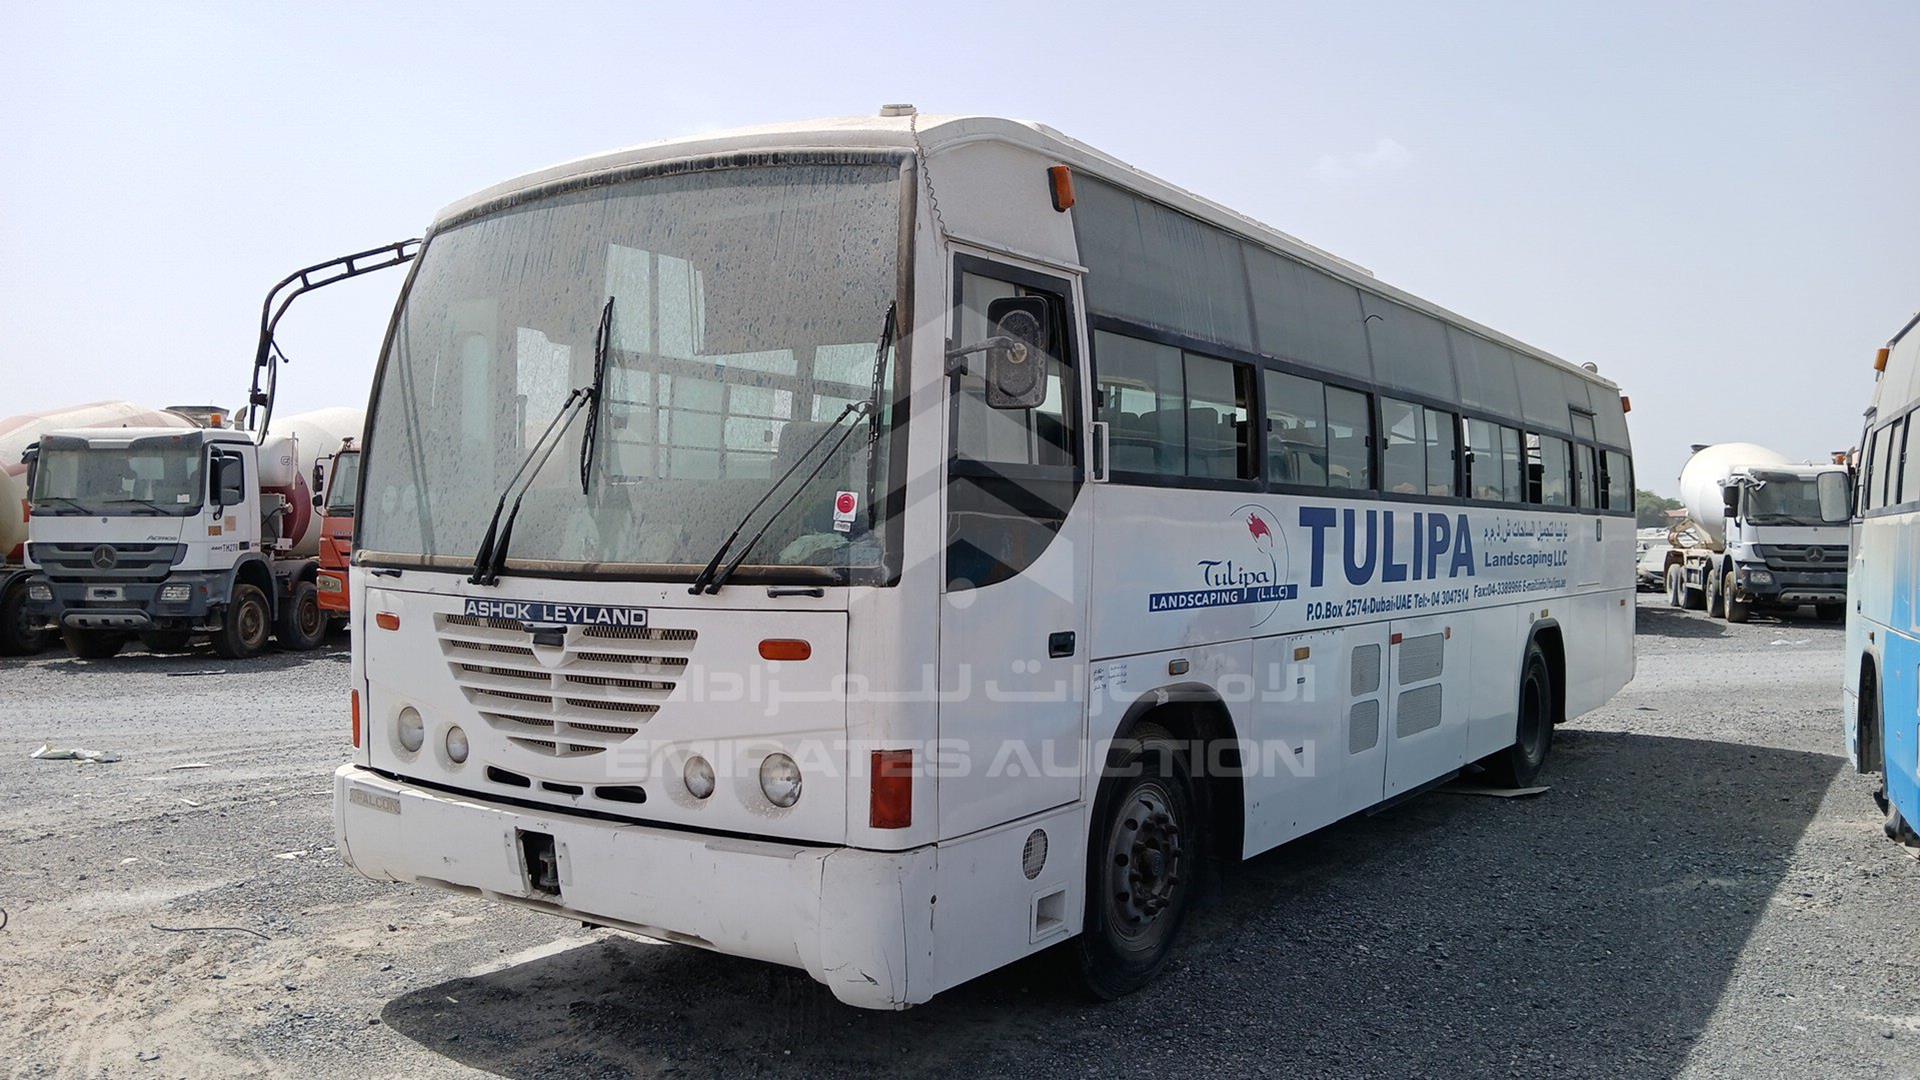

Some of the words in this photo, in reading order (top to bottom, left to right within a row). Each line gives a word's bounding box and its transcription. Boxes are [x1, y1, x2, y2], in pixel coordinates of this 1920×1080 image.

[1299, 506, 1475, 587] TULIPA
[1484, 550, 1553, 568] Landscaping
[1554, 549, 1568, 566] LLC
[1197, 560, 1270, 600] Tulipa
[1152, 591, 1239, 610] LANDSCAPING
[1257, 586, 1289, 601] (L.L.C)
[465, 600, 531, 620] ASHOK
[542, 605, 648, 627] LEYLAND
